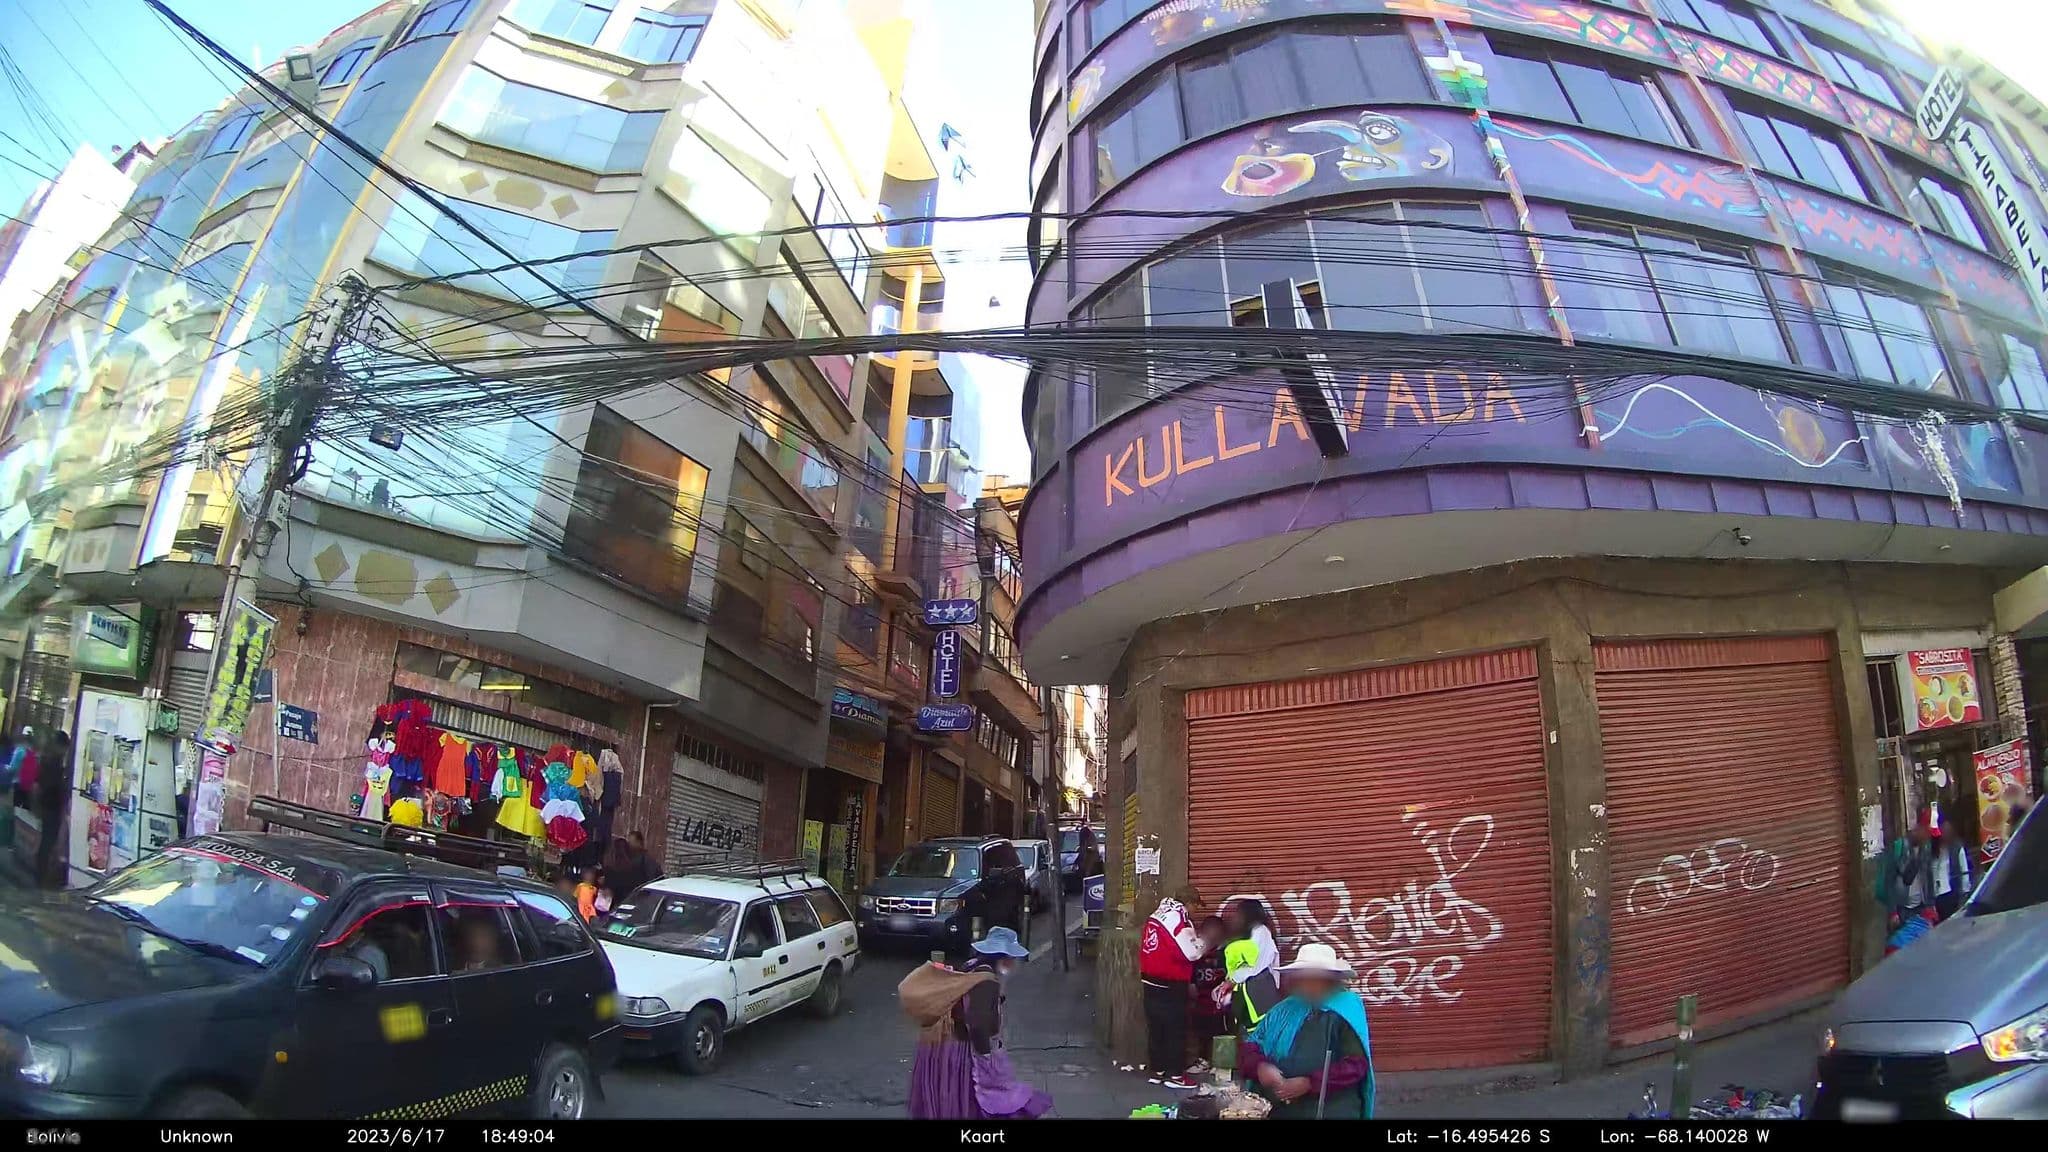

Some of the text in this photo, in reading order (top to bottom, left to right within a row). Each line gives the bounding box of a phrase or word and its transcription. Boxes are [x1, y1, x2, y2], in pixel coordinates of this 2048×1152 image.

[1919, 68, 1964, 137] HOTEL
[940, 631, 955, 695] HOTEL
[207, 841, 296, 880] TOYOSA S.A.
